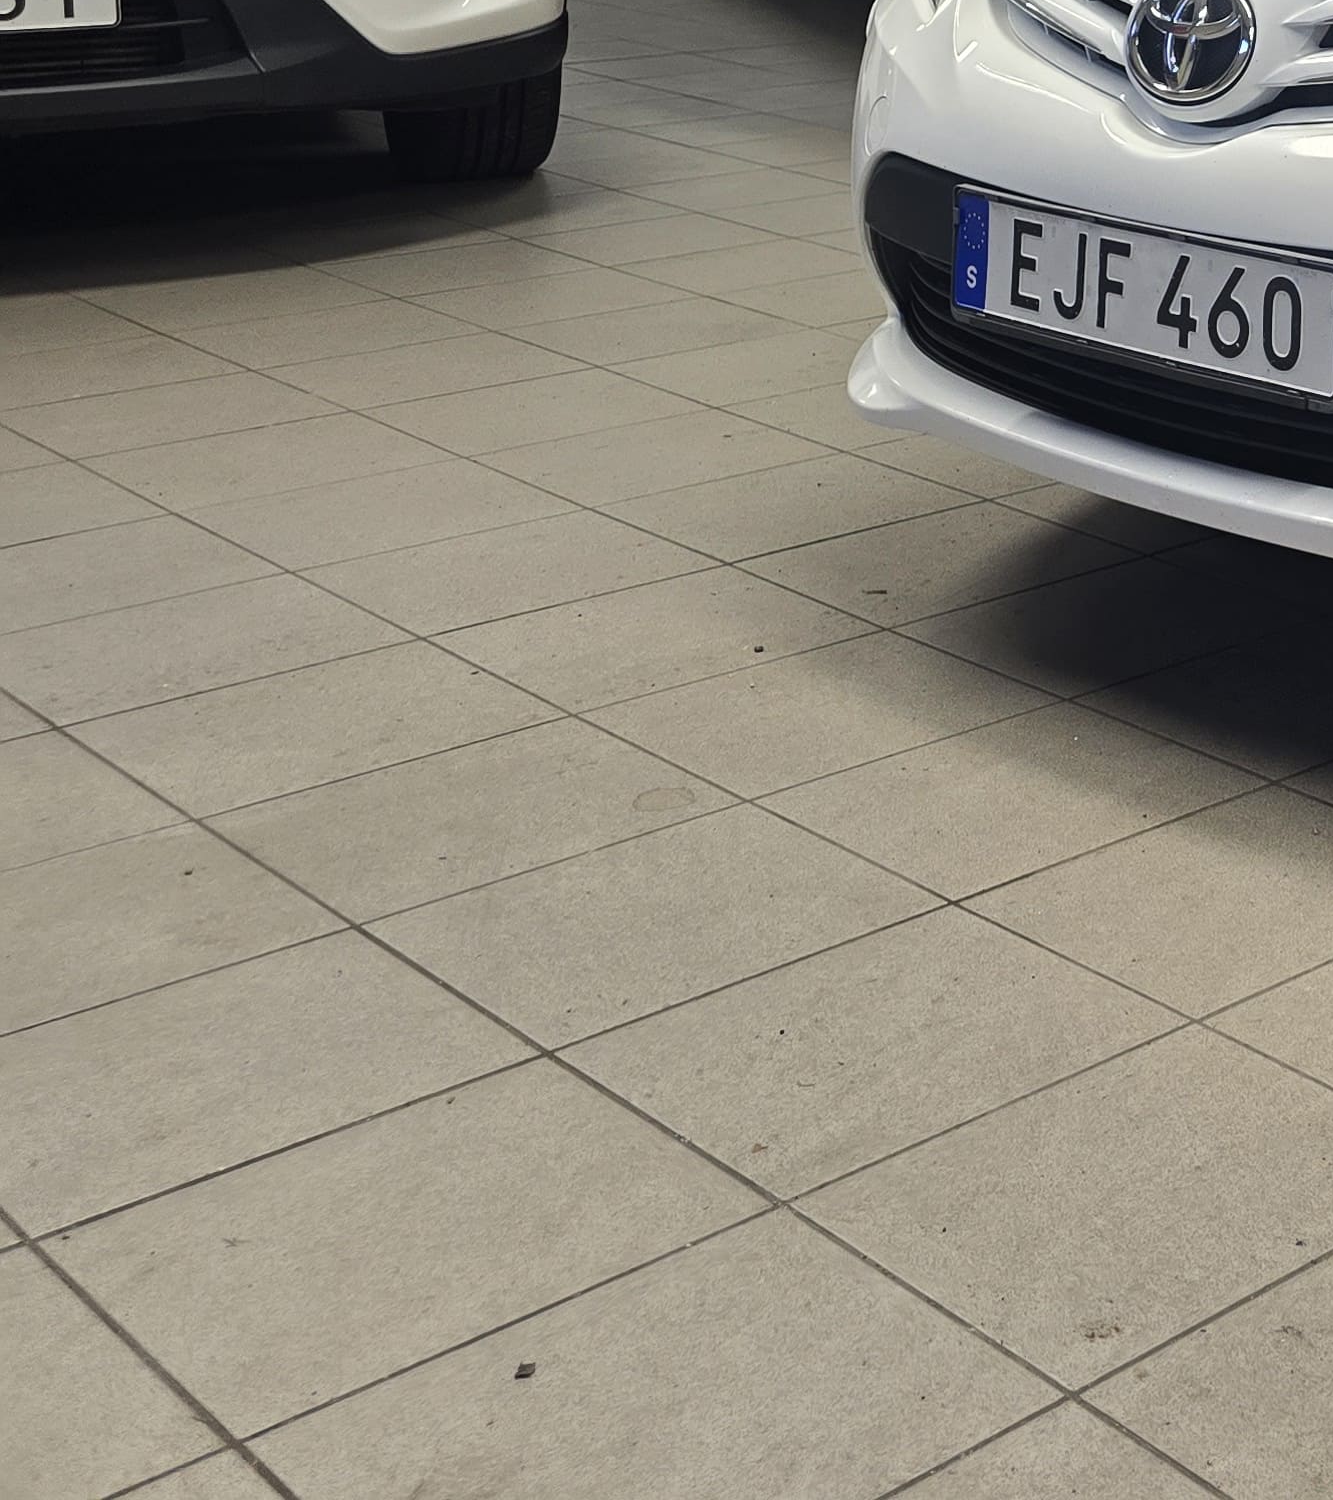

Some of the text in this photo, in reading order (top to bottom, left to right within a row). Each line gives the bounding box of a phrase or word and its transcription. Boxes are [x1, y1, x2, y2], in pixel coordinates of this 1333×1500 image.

[965, 265, 978, 289] S
[1010, 218, 1302, 371] EJF 460
